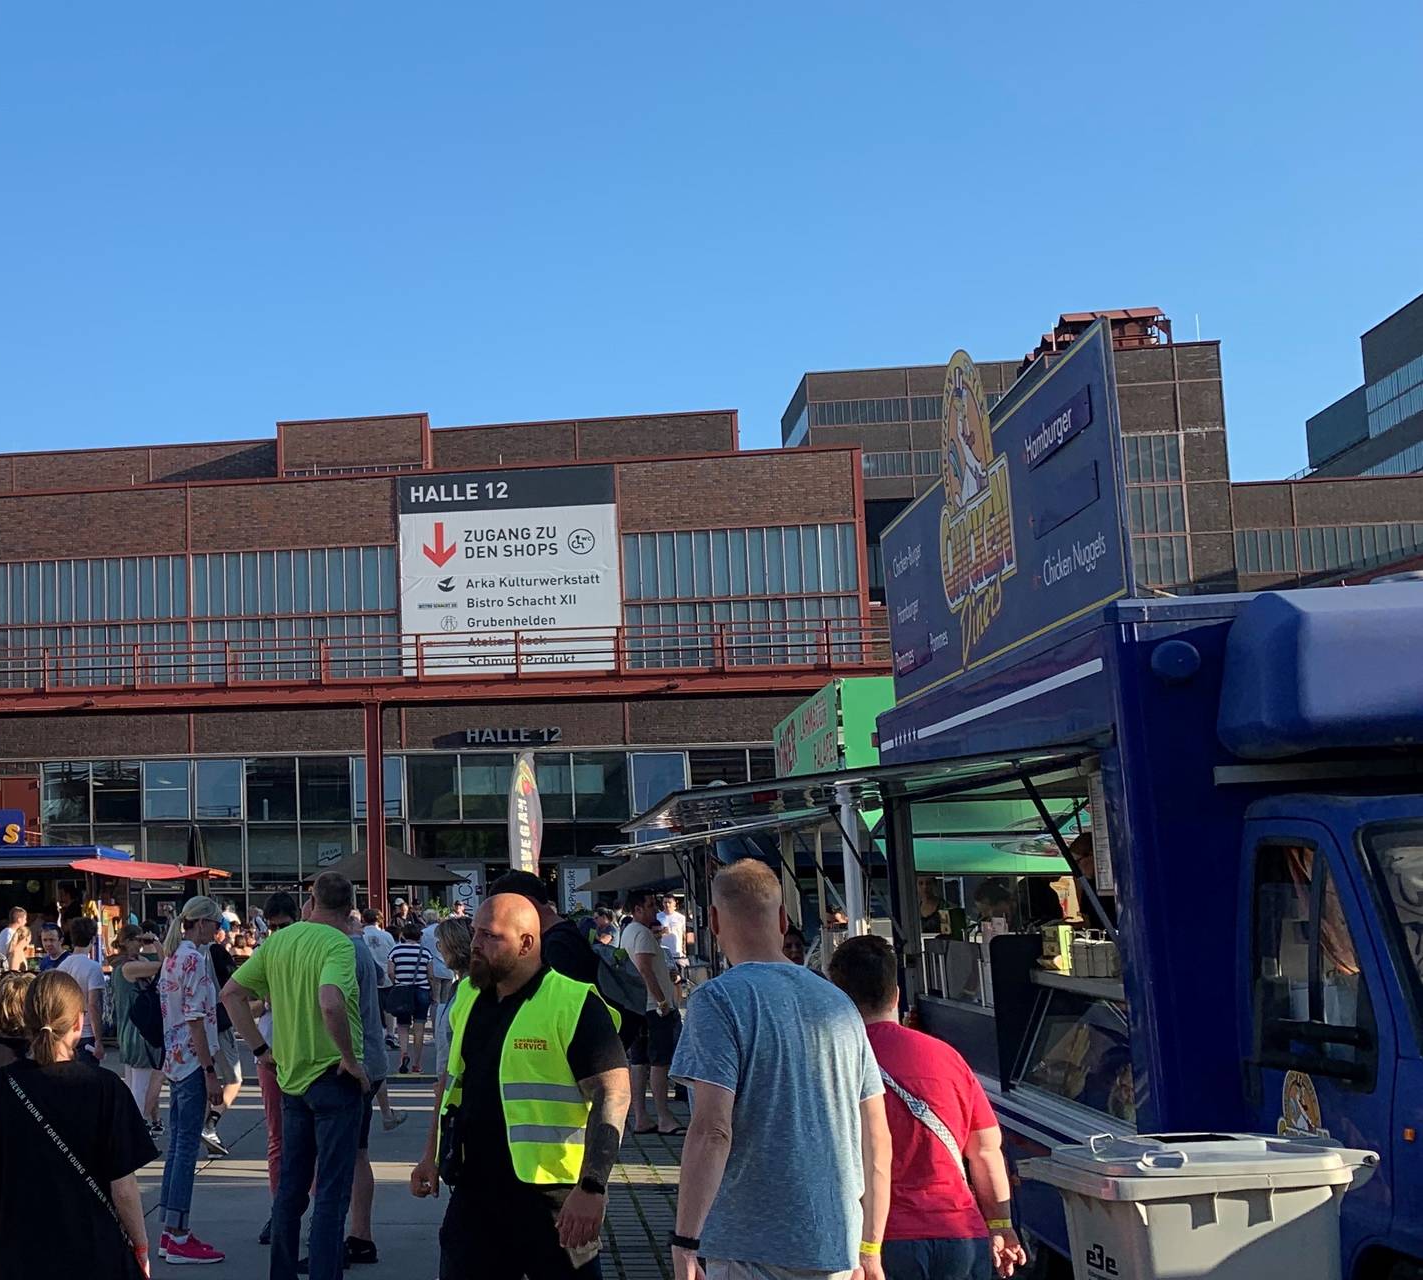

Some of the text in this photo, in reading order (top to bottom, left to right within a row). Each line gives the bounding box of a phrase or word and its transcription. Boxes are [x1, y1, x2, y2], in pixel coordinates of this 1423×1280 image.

[1024, 407, 1073, 466] Hamburger
[410, 481, 509, 503] HALLE 12
[464, 526, 557, 543] ZUGANG ZU
[465, 542, 558, 559] DEN SHOPS
[1042, 531, 1107, 587] Chicken Nuggets
[465, 573, 601, 590] Arka Kulturwerkstatt
[467, 593, 577, 609] Bistro Schacht XII
[467, 615, 556, 629] Grubenhelden
[465, 726, 563, 743] HALLE 12
[24, 1098, 44, 1124] YOUNG
[43, 1122, 70, 1154] FOREVER
[66, 1151, 87, 1176] YOUNG
